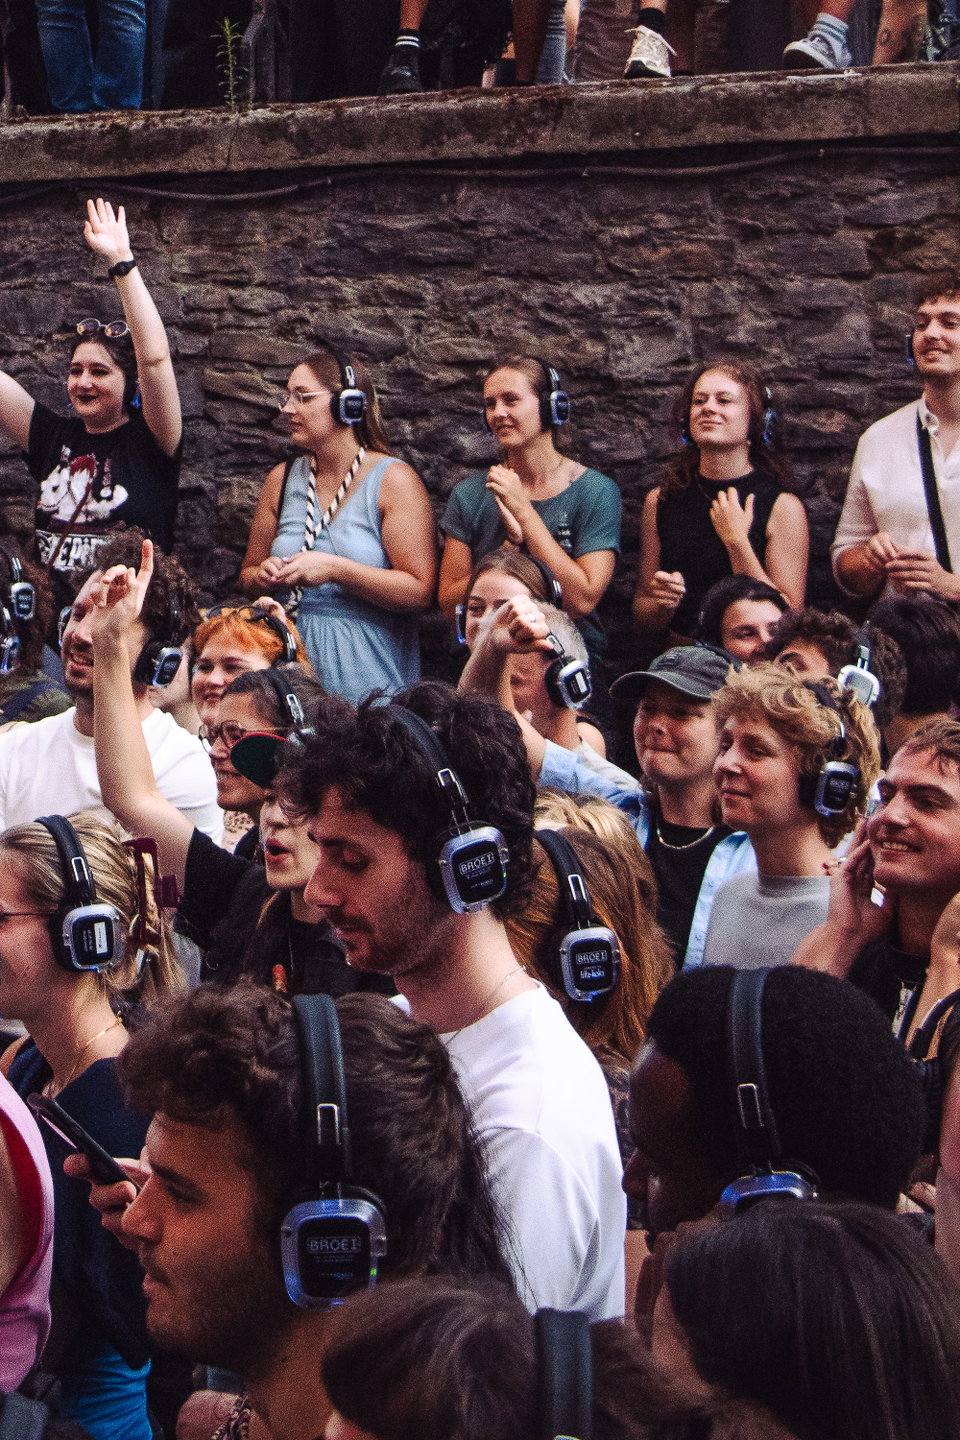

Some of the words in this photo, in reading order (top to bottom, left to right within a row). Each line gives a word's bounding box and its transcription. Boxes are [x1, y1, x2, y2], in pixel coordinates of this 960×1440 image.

[460, 854, 492, 873] BROEI
[577, 951, 604, 963] BROEI
[310, 1238, 358, 1252] BROEI
